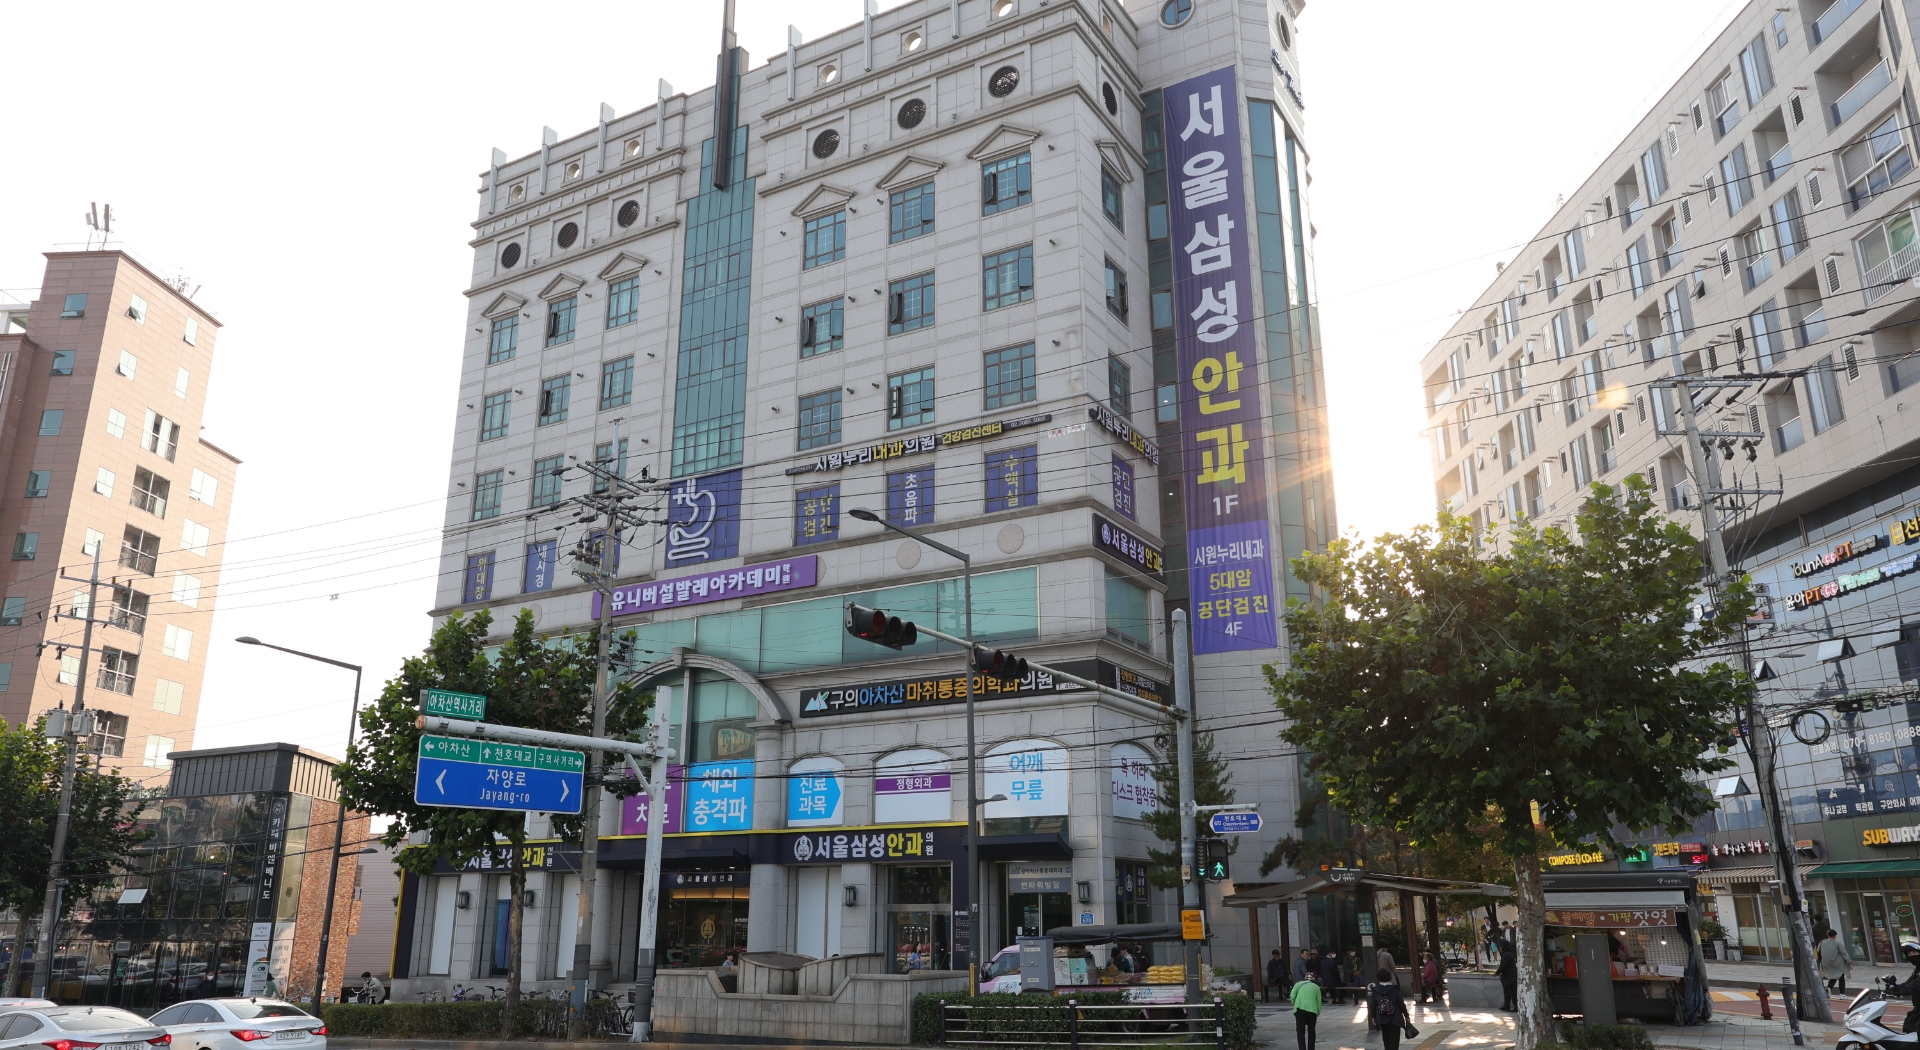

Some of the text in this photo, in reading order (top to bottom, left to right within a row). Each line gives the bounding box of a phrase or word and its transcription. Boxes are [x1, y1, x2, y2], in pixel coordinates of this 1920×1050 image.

[1180, 85, 1250, 484] 서울삼성안과
[1097, 406, 1159, 465] 시원누리내과의원
[814, 422, 1003, 472] 시원누리내과의원 건강검진센터
[1004, 454, 1019, 508] 수액실
[804, 494, 833, 516] 공단
[904, 473, 918, 524] 초음파
[1213, 494, 1239, 516] 1F
[1112, 528, 1160, 573] 서울삼성안과
[1194, 538, 1265, 566] 시원누리내과
[1789, 554, 1823, 577] YounA
[1835, 541, 1853, 561] PT
[535, 544, 548, 588] 내시경
[475, 557, 487, 600] 위대장
[611, 563, 792, 611] 유니버설발레아카데미 학원
[1209, 568, 1252, 592] 5대암
[1197, 594, 1269, 621] 공단검진
[1224, 621, 1243, 637] 4F
[428, 694, 483, 715] 아차산역사거리
[830, 683, 905, 710] 구의아차산
[1869, 731, 1892, 745] 8150
[438, 741, 471, 758] 아차산
[494, 747, 532, 762] 천호대교
[538, 752, 574, 768] 구의사거리
[1009, 752, 1045, 774] 어깨
[1121, 757, 1129, 777] 목
[486, 768, 527, 789] 자양로
[701, 765, 738, 794] 체외
[799, 774, 828, 795] 진료
[895, 777, 933, 790] 정형외과
[480, 787, 530, 804] Jayang-ro
[1009, 779, 1045, 801] 무릎
[1111, 780, 1157, 807] 디스크 협착증
[692, 797, 748, 826] 충격파
[798, 796, 828, 816] 과목
[1880, 797, 1906, 809] 구안와사
[814, 831, 935, 860] 서울삼성안과 의원
[1862, 824, 1920, 846] SUBWAY
[546, 846, 554, 867] 의원
[1747, 839, 1762, 854] 식당
[1548, 854, 1575, 866] COMPOSE
[687, 874, 734, 883] 서울삼성안과
[1562, 909, 1668, 927] 붕어빵 가평 잣엿
